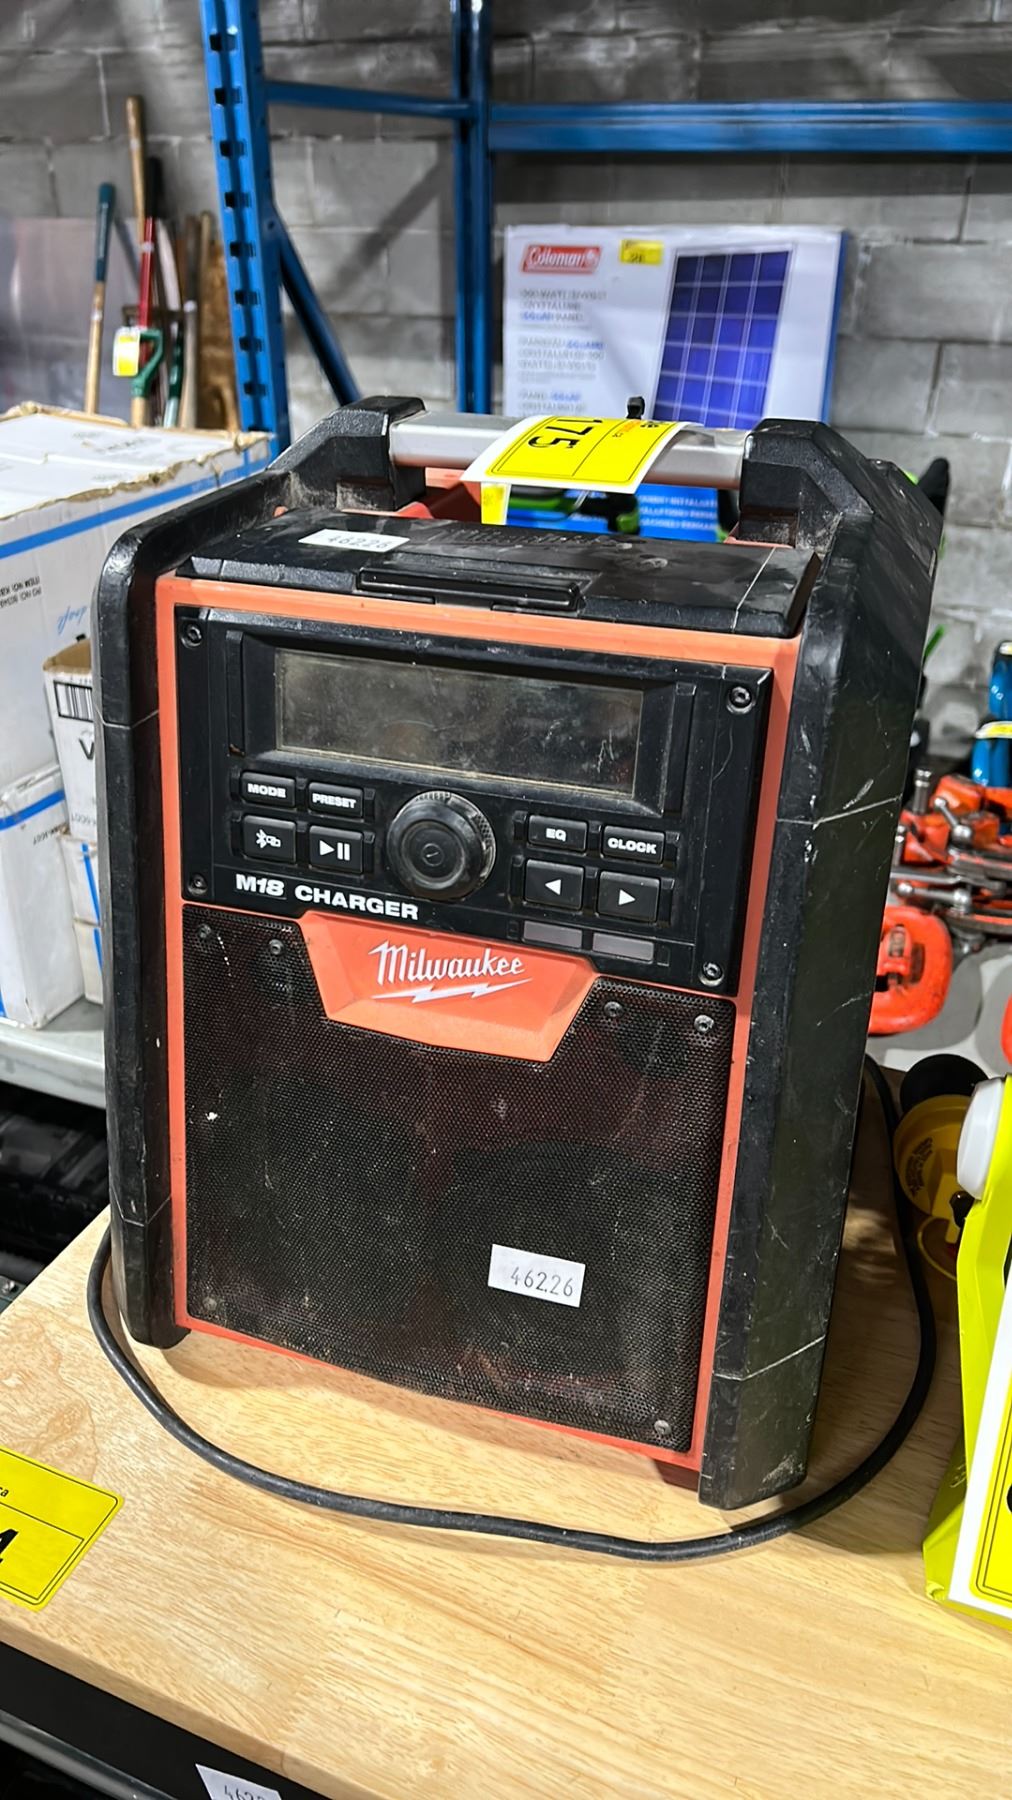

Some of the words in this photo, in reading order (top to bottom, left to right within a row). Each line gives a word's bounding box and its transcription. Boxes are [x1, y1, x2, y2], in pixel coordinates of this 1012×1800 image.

[527, 247, 586, 267] Coleman
[247, 783, 287, 798] MODE
[312, 793, 356, 809] PRESET
[545, 828, 567, 842] EQ
[607, 838, 657, 854] CLOCK
[235, 874, 285, 897] M18
[294, 885, 419, 920] CHARGER
[368, 940, 525, 986] Milwaukee
